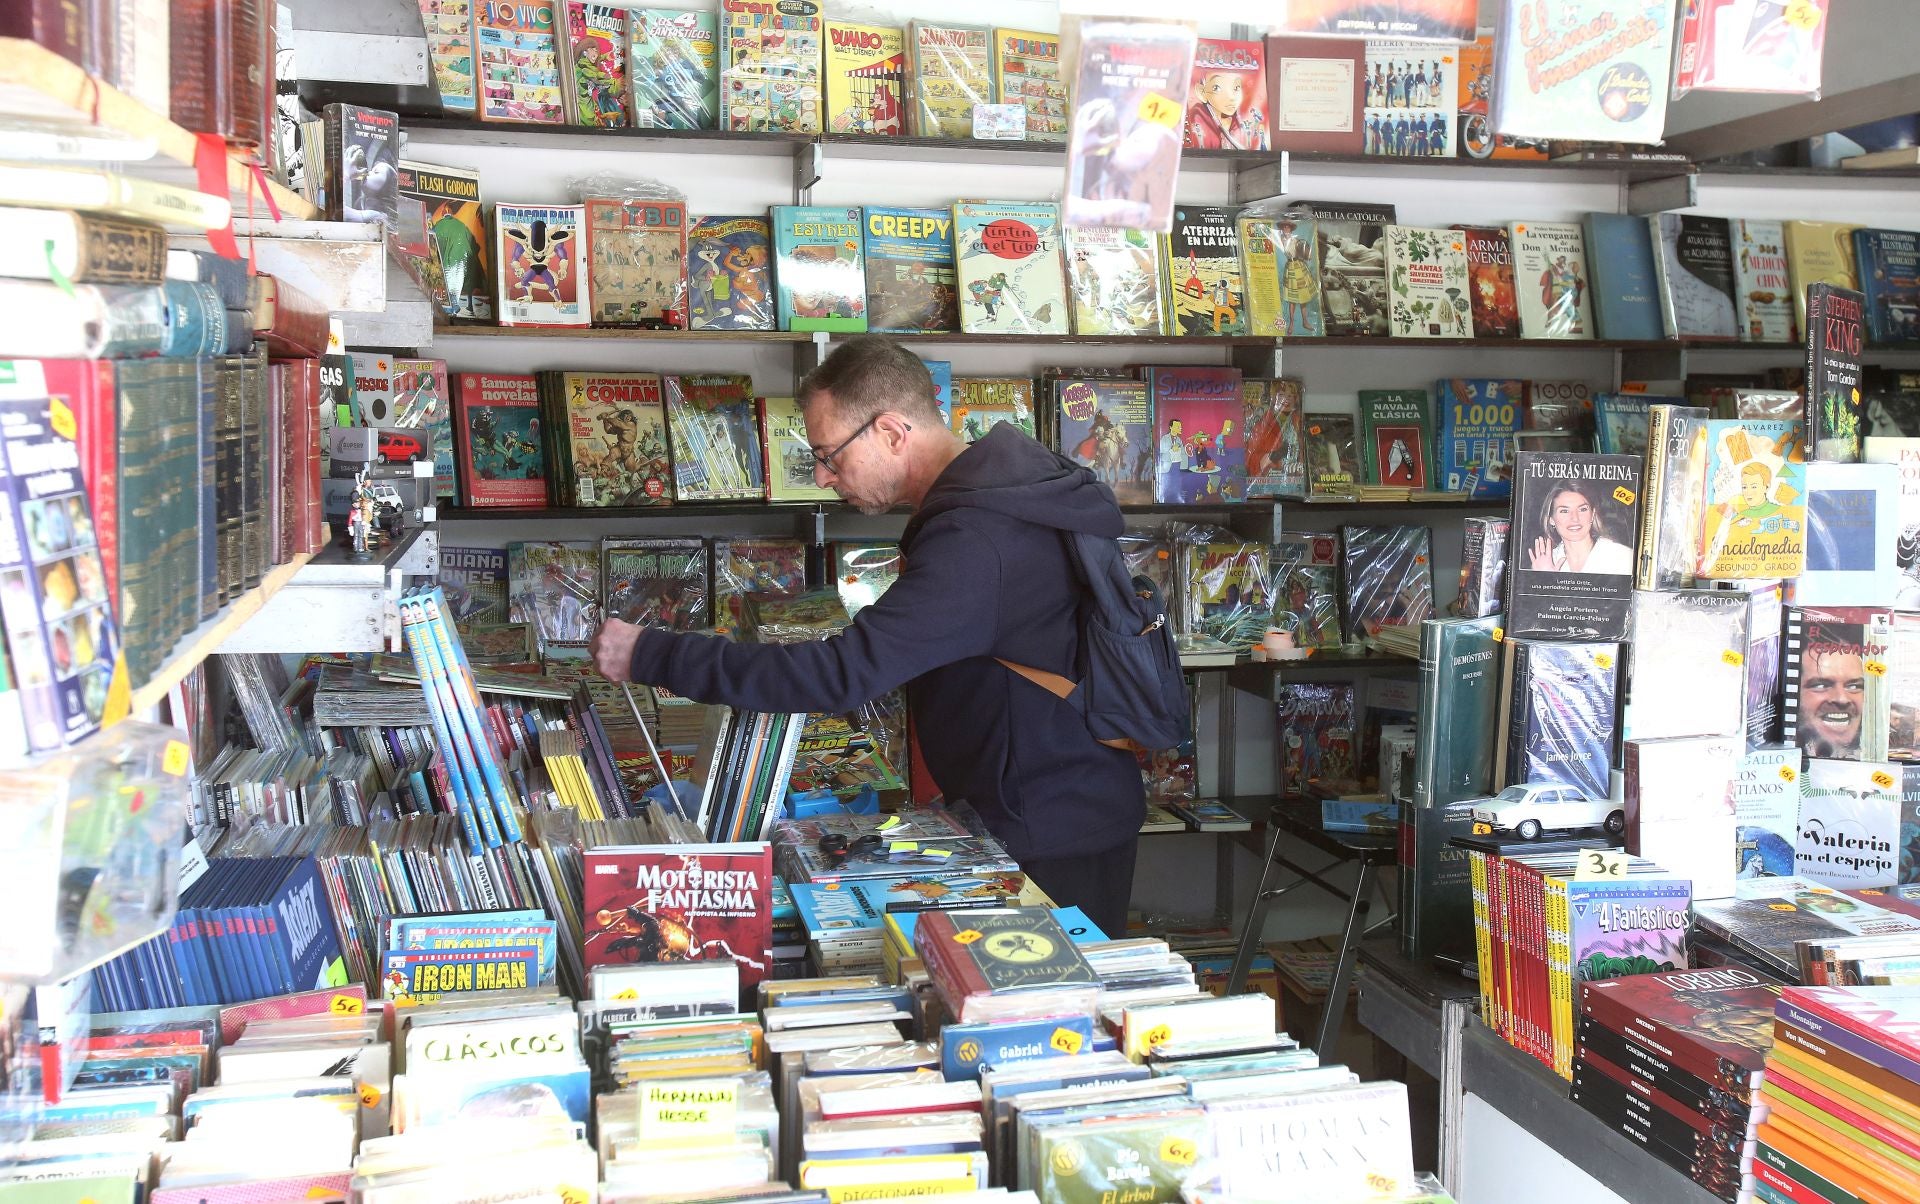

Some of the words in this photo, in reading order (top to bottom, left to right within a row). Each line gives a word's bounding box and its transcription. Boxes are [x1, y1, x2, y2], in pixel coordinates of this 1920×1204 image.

[754, 14, 819, 31] PULGARCITO
[830, 28, 882, 49] DUMBO
[420, 175, 443, 192] FLASH
[446, 180, 477, 197] GORDON
[501, 207, 548, 224] DRAGON
[550, 209, 576, 225] BALL
[625, 207, 681, 227] TBO
[1335, 212, 1344, 220] LA
[1347, 212, 1386, 222] CATÓLICA
[793, 223, 859, 237] ESTHER
[869, 215, 951, 240] CREEPY
[1526, 230, 1538, 240] La
[1540, 231, 1579, 241] venganza
[972, 241, 989, 251] en
[993, 238, 1007, 251] el
[1188, 237, 1199, 246] EN
[1202, 237, 1216, 246] LA
[1521, 243, 1541, 253] Don
[1550, 244, 1580, 254] Mendo
[1409, 264, 1442, 272] PLANTAS
[1825, 294, 1861, 319] STEPHEN
[1825, 318, 1860, 356] KING
[481, 377, 536, 388] famosas
[1159, 374, 1236, 395] SIMPSON
[1827, 371, 1838, 382] Tom
[1839, 372, 1856, 385] Gordon
[482, 388, 538, 401] novelas
[586, 386, 660, 403] CONAN
[1533, 383, 1587, 399] 1000
[1373, 410, 1420, 419] CLÁSICA
[1454, 405, 1514, 424] 1.000
[1604, 402, 1614, 413] La
[1616, 402, 1636, 413] mula
[774, 429, 785, 437] EN
[1673, 417, 1688, 438] SOY
[1741, 423, 1784, 431] ALVAREZ
[1669, 440, 1689, 458] C-3PO
[1530, 461, 1546, 477] TÚ
[1549, 460, 1580, 479] SERÁS
[1583, 464, 1597, 479] MI
[1599, 464, 1633, 481] REINA
[1715, 563, 1758, 572] SEGUNDO
[1765, 562, 1797, 572] GRADO
[1550, 604, 1572, 613] Ángela
[1574, 605, 1598, 613] Portero
[1691, 597, 1743, 607] MORTON
[1806, 615, 1829, 624] Stephen
[1831, 616, 1845, 624] King
[1809, 627, 1820, 638] El
[1808, 641, 1888, 656] resplandor
[1453, 651, 1494, 666] DEMÓSTENES
[1546, 753, 1568, 762] James
[1570, 752, 1591, 762] Joyce
[1804, 819, 1890, 852] Valeria
[1589, 853, 1620, 876] 3€
[1796, 853, 1812, 861] en
[1818, 852, 1829, 862] el
[1835, 855, 1892, 874] espejo
[647, 887, 755, 913] FANTASMA
[684, 910, 715, 918] AUTOPISTA
[1599, 903, 1610, 932] 4
[1611, 904, 1689, 931] Fantásticos
[413, 963, 472, 992] IRON
[475, 961, 527, 990] MAN
[1653, 969, 1759, 992] LOBEZNO
[334, 999, 356, 1013] 5€
[602, 1013, 628, 1023] ALBERT
[1789, 1009, 1822, 1032] Montaigne
[424, 1033, 564, 1061] CLÁSICOS
[1000, 1044, 1042, 1057] Gabriel
[1785, 1030, 1799, 1042] Von
[1801, 1038, 1826, 1056] Neumann
[650, 1087, 732, 1103] HERMANN
[659, 1110, 708, 1123] HESSE
[1767, 1152, 1786, 1169] Turing
[1764, 1170, 1793, 1193] Descartes
[843, 1186, 944, 1202] DICCIONARIO
[1102, 1190, 1117, 1204] El
[1120, 1186, 1155, 1204] árbol
